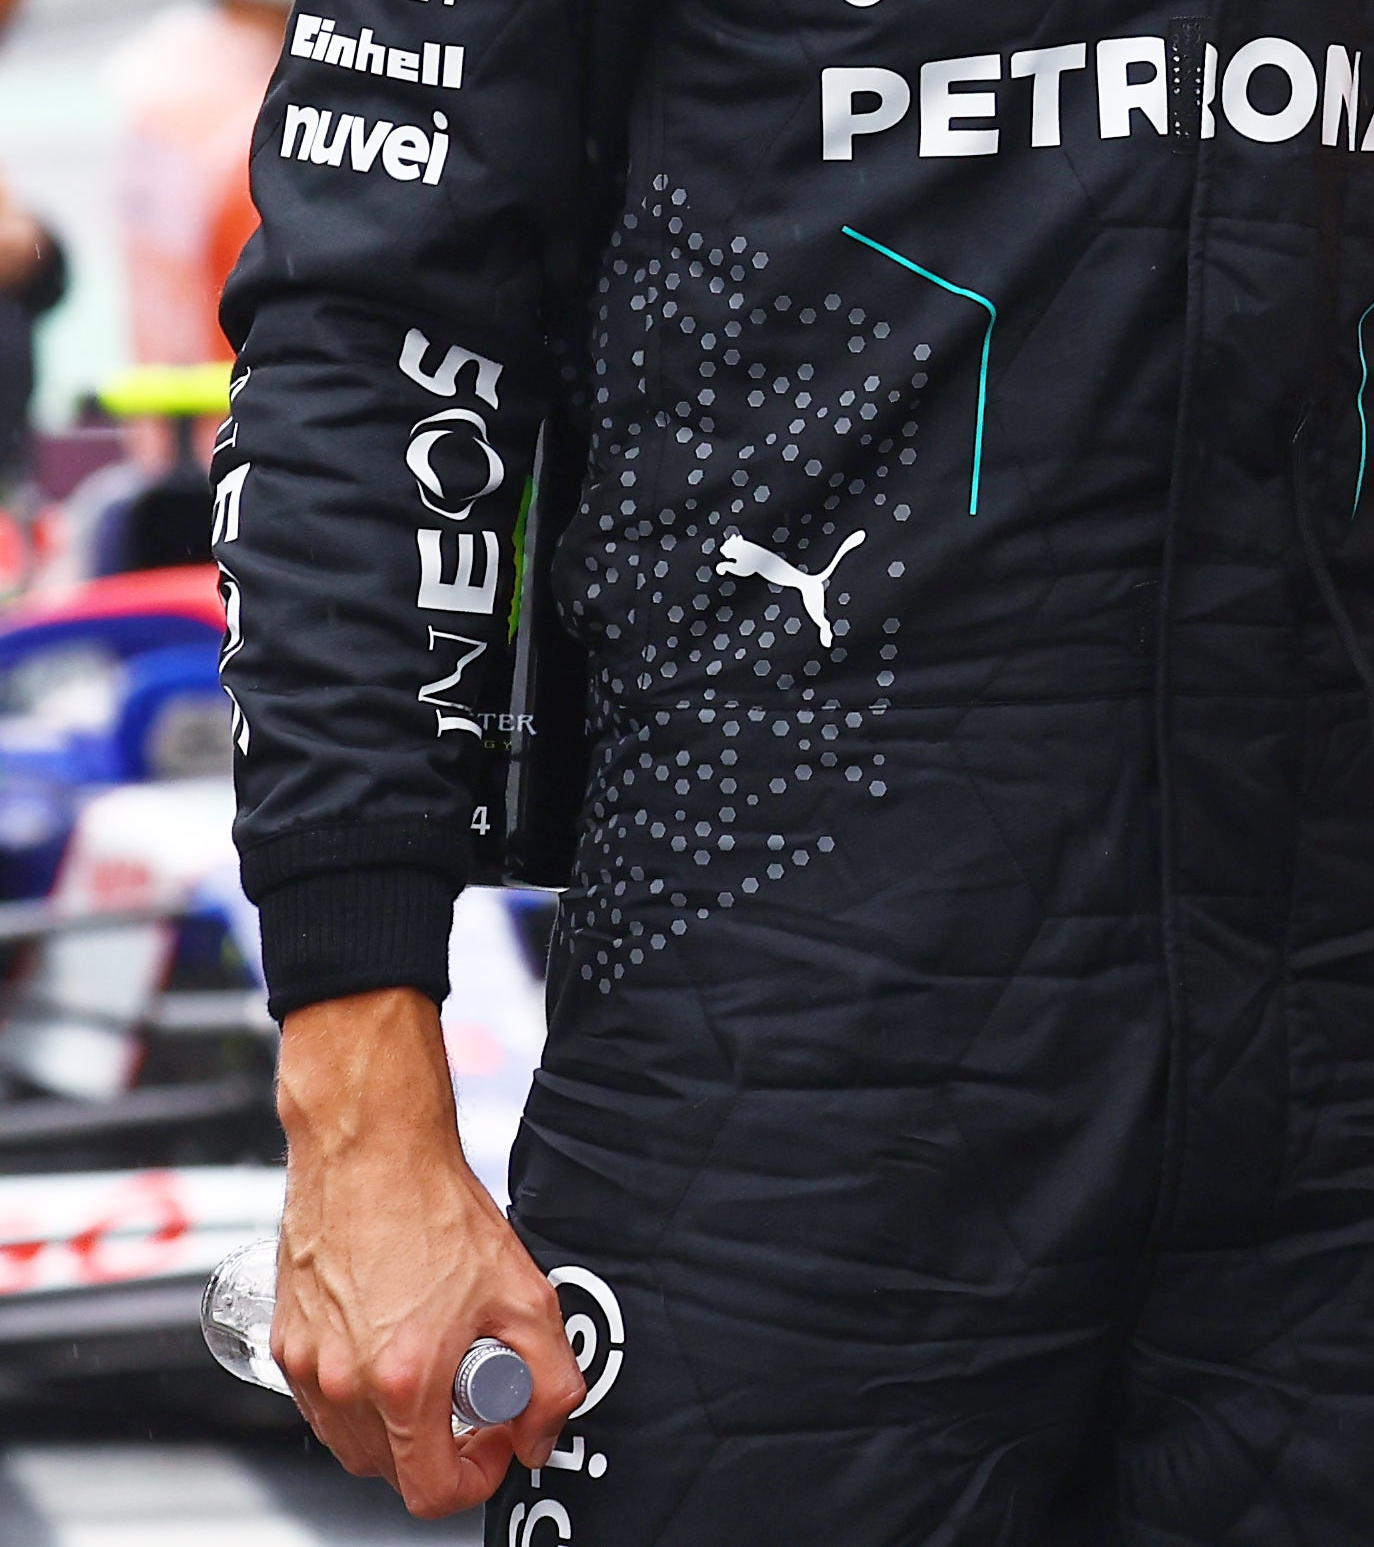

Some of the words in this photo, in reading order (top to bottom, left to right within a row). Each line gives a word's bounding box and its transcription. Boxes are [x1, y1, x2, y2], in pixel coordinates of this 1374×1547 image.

[290, 12, 466, 90] Einhell
[280, 103, 450, 186] nuvei
[399, 327, 504, 740] INEOS
